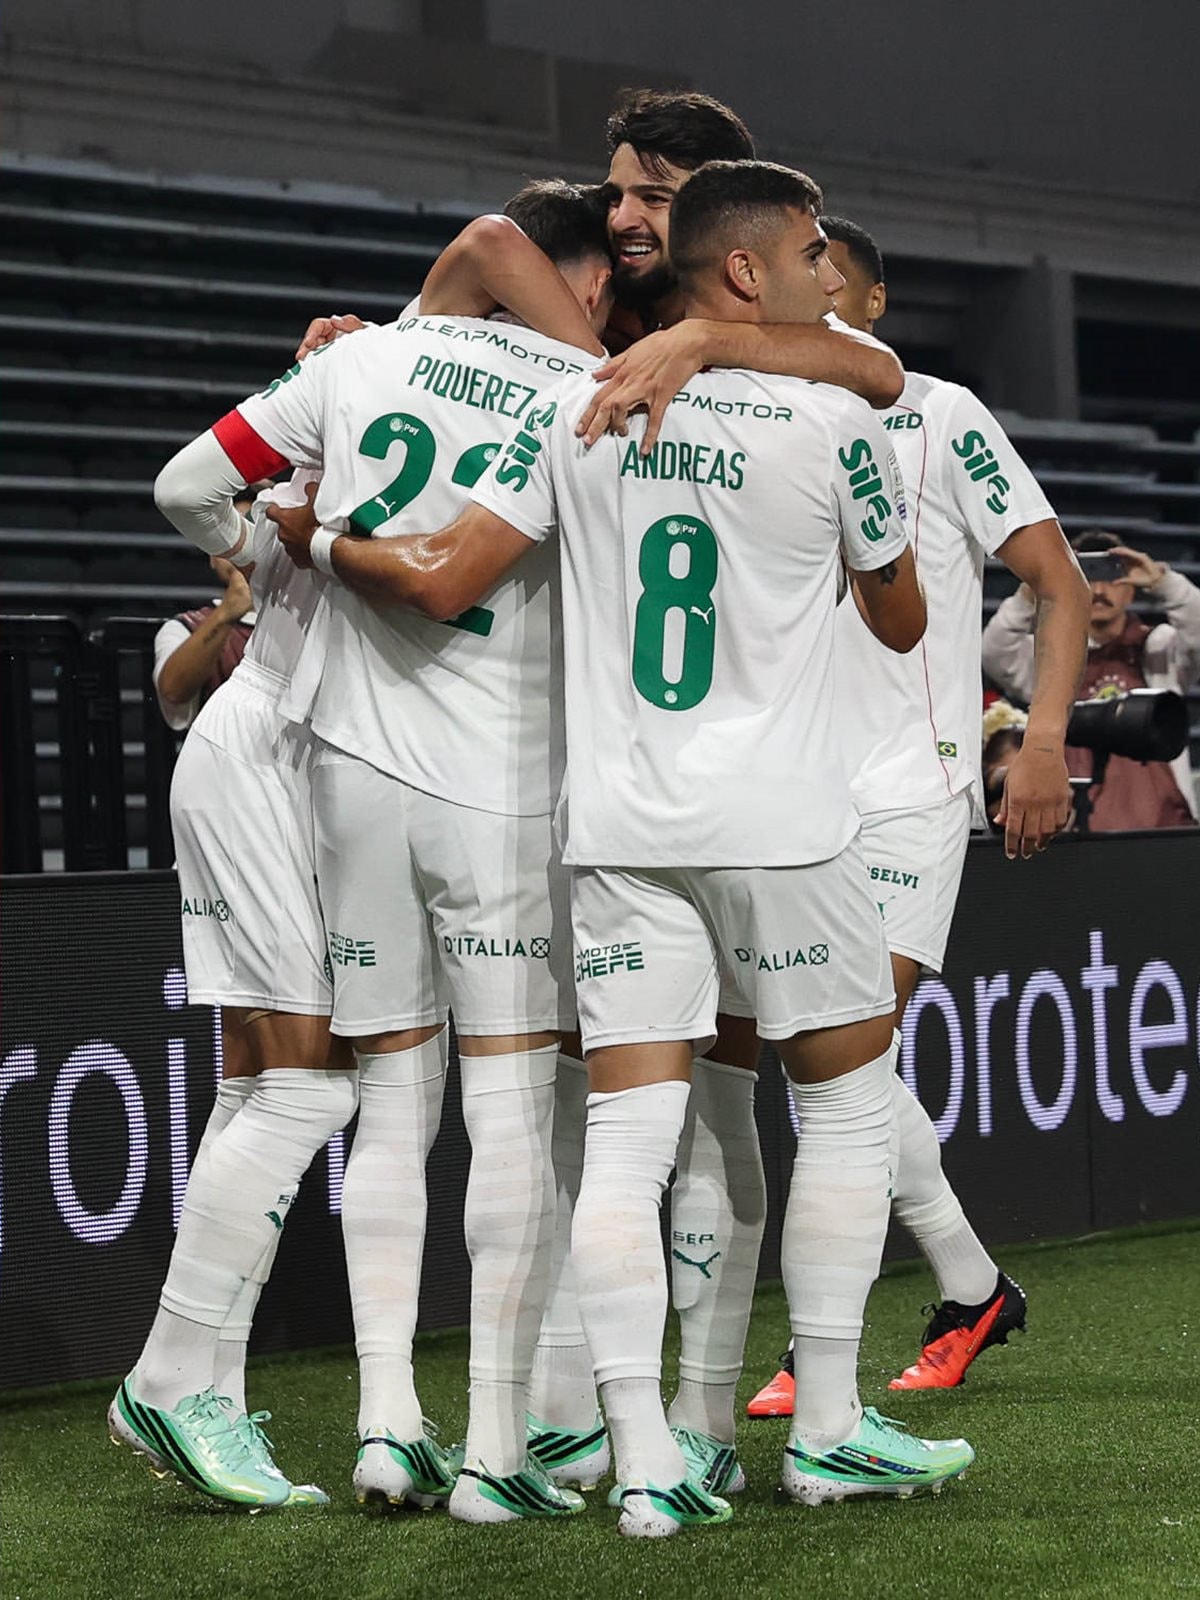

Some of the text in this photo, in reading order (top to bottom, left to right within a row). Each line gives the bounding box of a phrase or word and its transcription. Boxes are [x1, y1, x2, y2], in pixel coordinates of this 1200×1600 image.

[408, 354, 538, 420] PIQUEREZ
[672, 391, 793, 422] PMOTOR
[403, 423, 420, 436] Pay
[620, 440, 747, 491] ANDREAS
[682, 524, 698, 535] Pay
[632, 514, 719, 712] 8
[866, 865, 919, 889] SELVI
[182, 897, 217, 917] ALIA
[444, 935, 528, 957] D'ITALIA
[579, 943, 621, 959] MOTO
